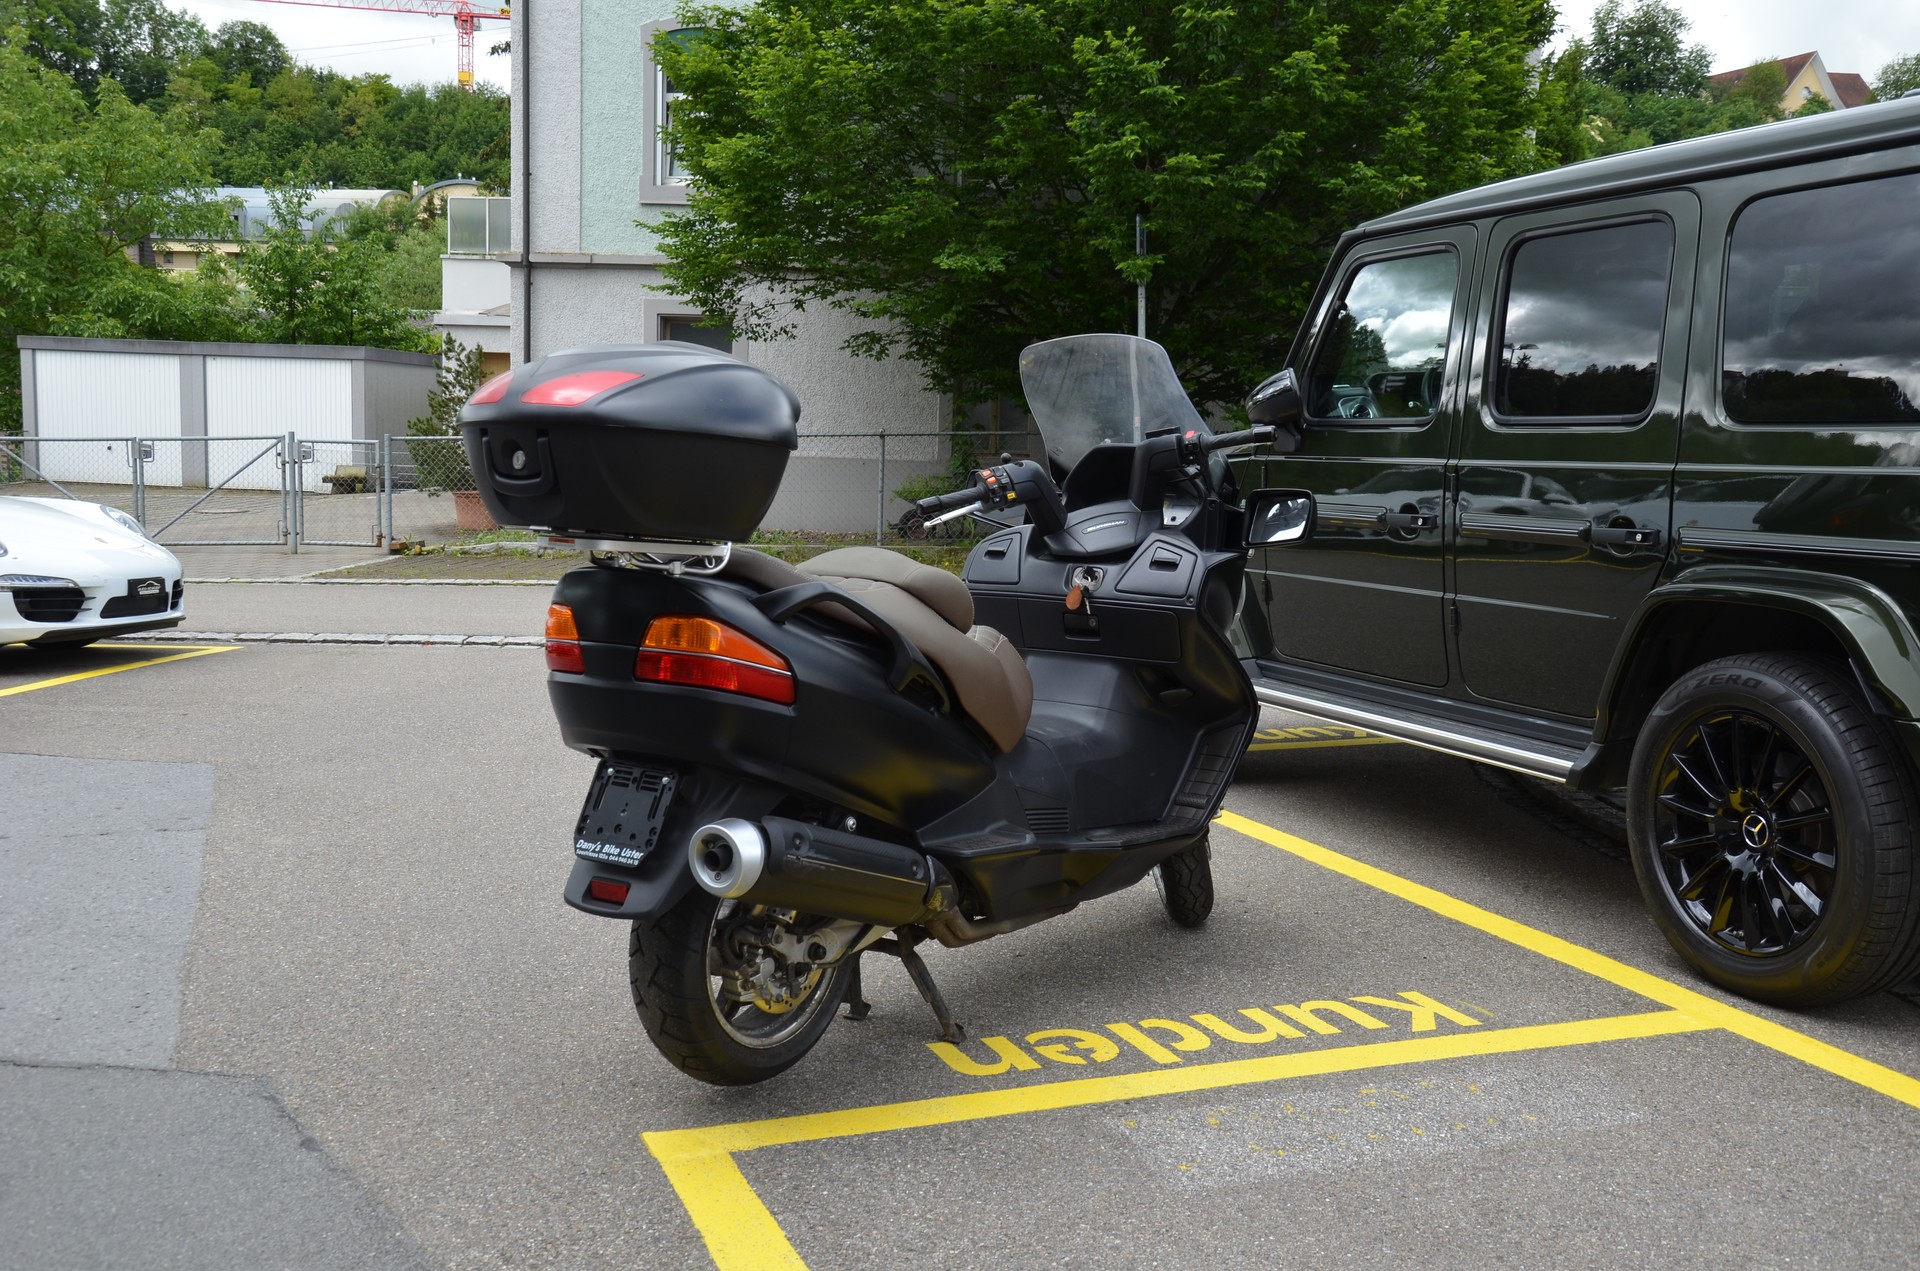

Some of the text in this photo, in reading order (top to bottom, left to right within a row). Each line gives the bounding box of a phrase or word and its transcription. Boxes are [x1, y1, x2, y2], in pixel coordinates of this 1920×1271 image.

[1692, 673, 1764, 690] ZERO
[576, 839, 644, 859] Dany's Bike Uster
[926, 991, 1482, 1075] Kunden
